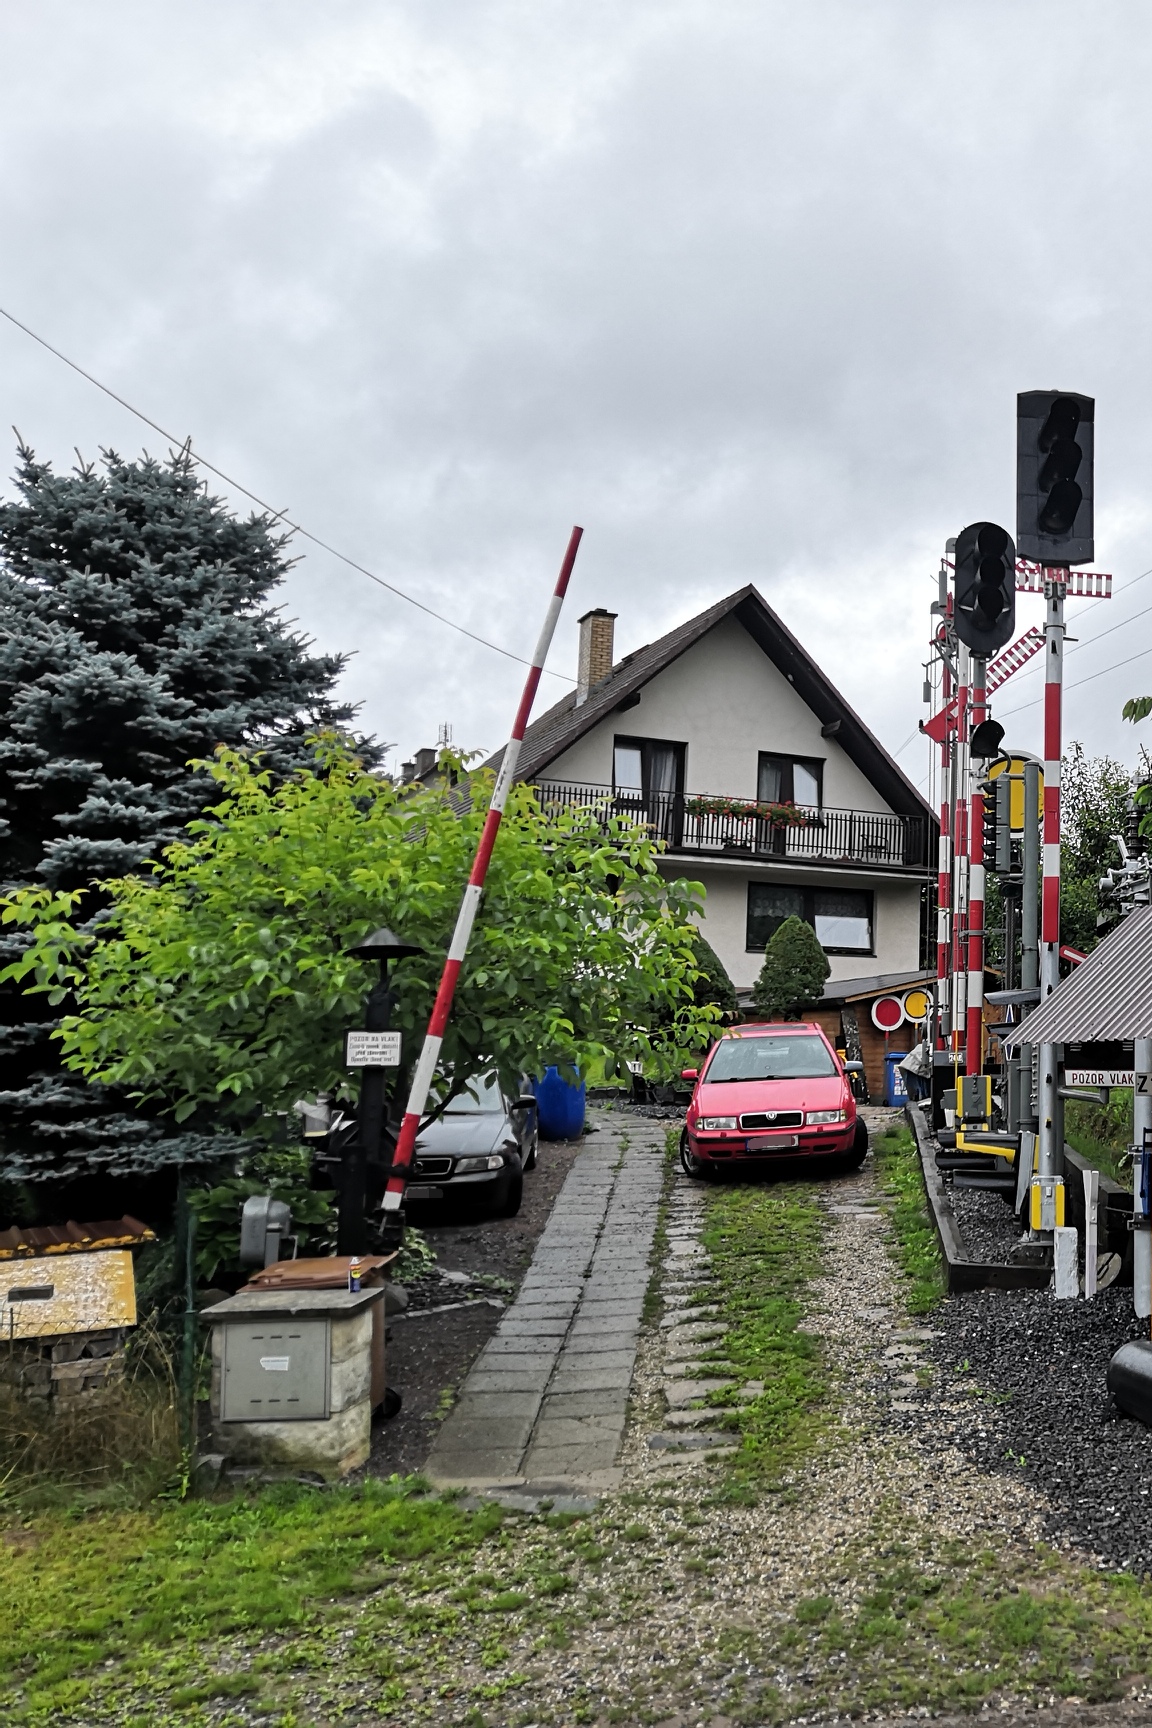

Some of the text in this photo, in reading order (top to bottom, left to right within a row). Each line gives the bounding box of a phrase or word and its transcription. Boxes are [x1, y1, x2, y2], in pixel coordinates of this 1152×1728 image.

[1072, 1073, 1134, 1085] POZOR VLAK
[1137, 1075, 1149, 1093] Z
